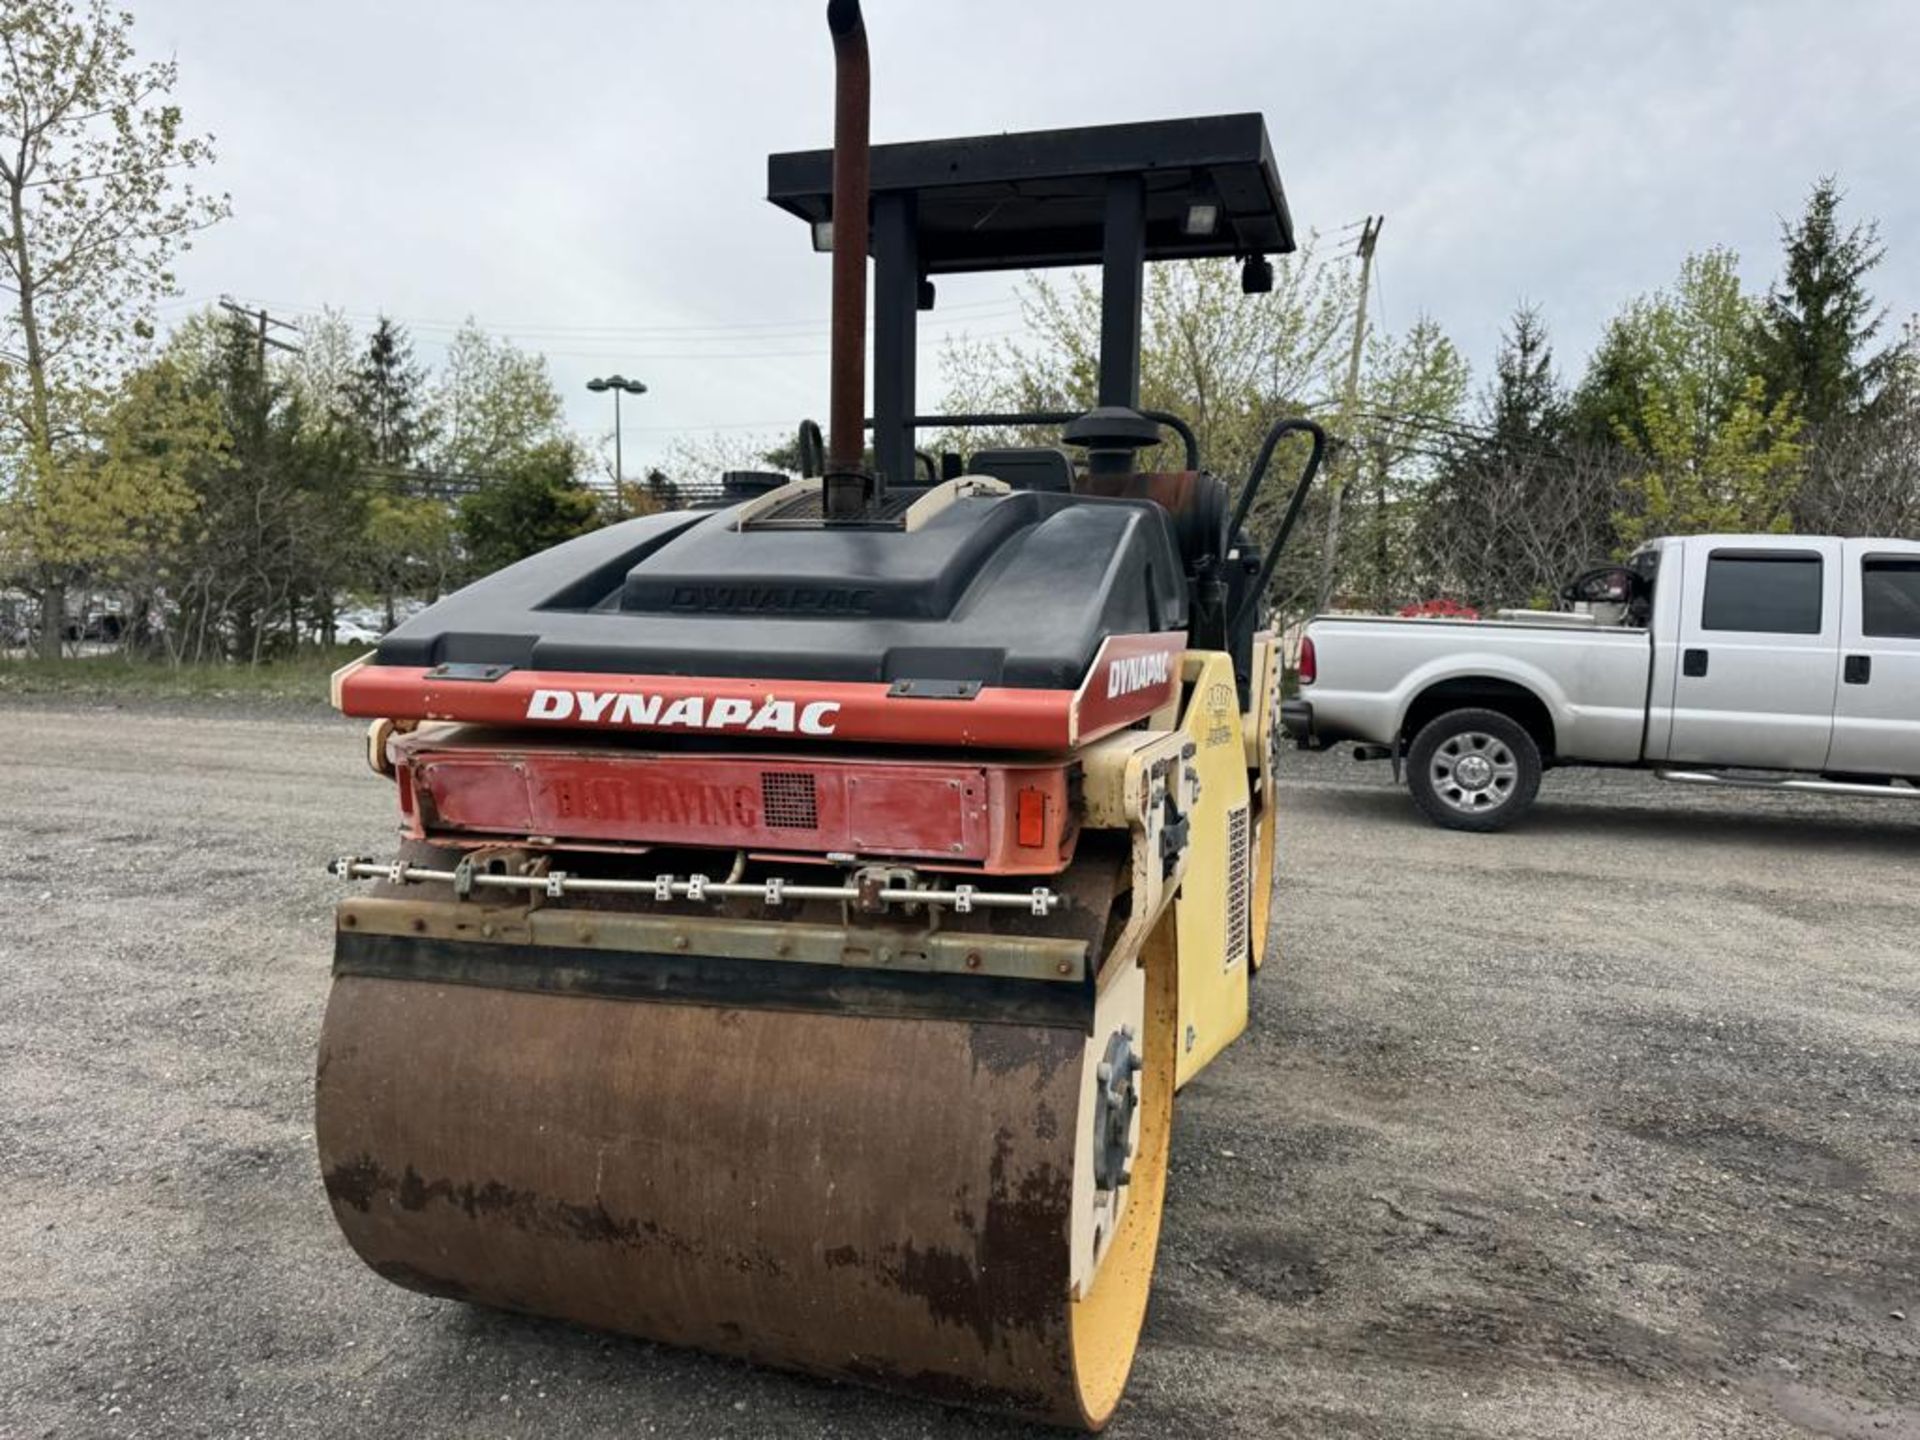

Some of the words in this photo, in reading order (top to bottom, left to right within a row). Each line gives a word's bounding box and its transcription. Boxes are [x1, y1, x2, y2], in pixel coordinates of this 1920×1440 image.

[671, 586, 874, 614] DYNAPAC
[1107, 650, 1169, 699] DYNAPAC
[526, 689, 841, 735] DYNAPAC
